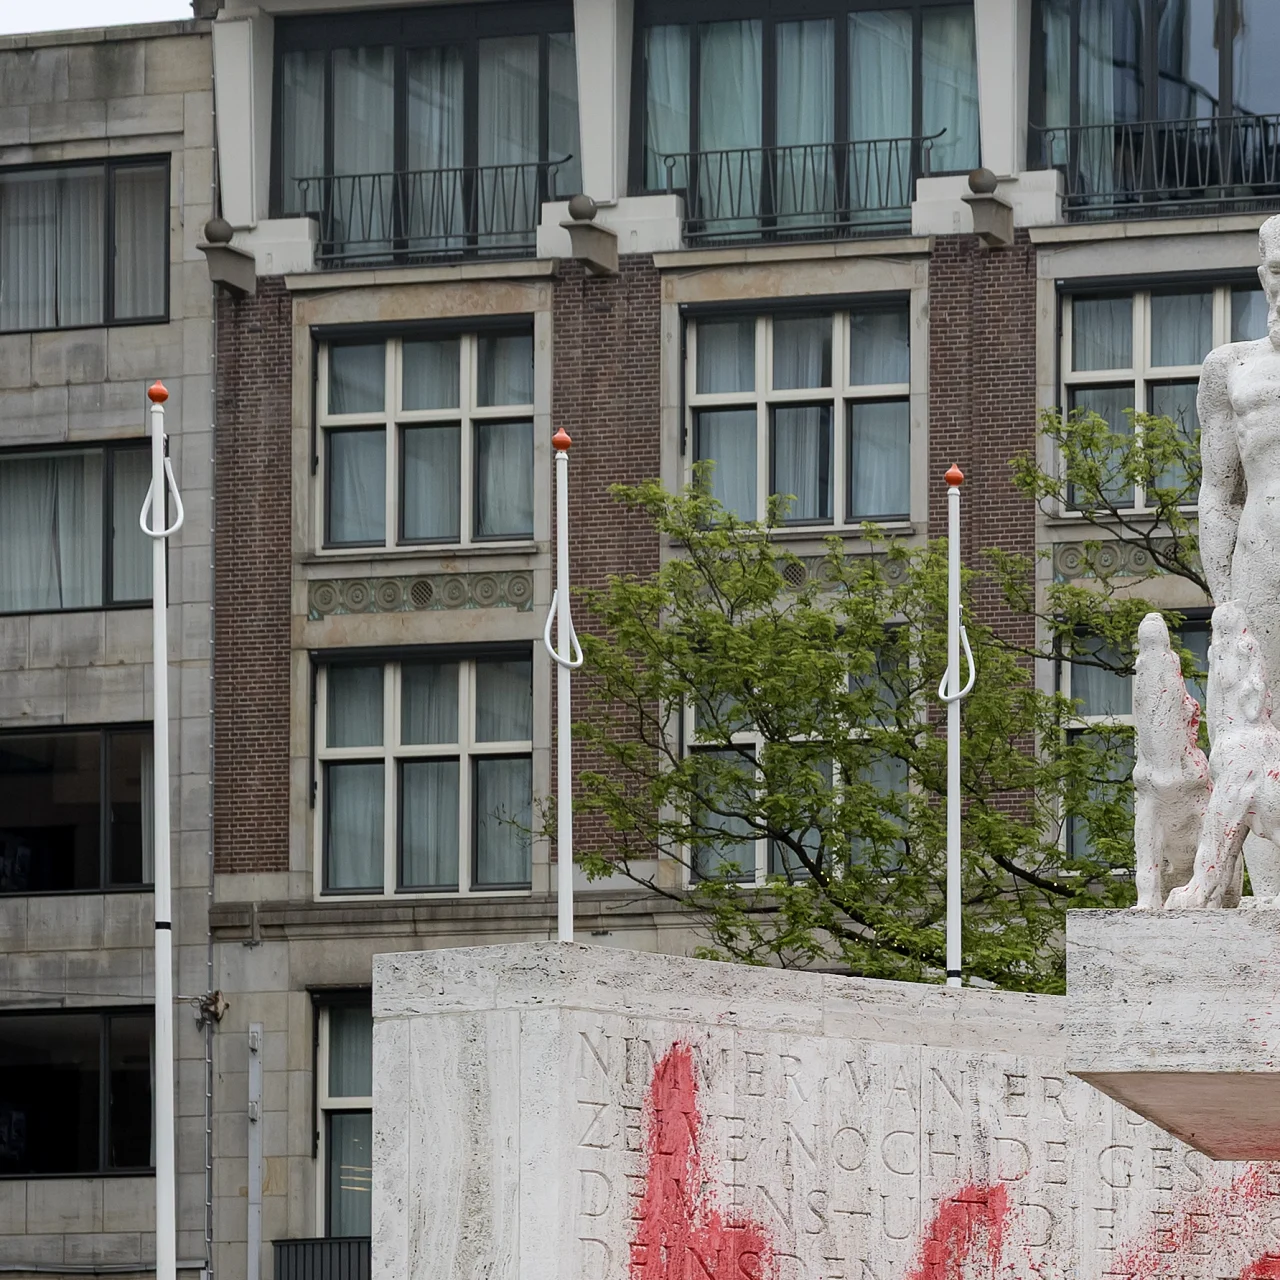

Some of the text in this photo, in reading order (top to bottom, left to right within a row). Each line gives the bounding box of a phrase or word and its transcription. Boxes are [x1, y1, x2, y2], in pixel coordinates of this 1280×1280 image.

[838, 1058, 966, 1115] VAN
[781, 1119, 962, 1178] NOCH
[993, 1134, 1068, 1186] DE
[577, 1167, 648, 1222] DE
[1017, 1201, 1118, 1252] DIE
